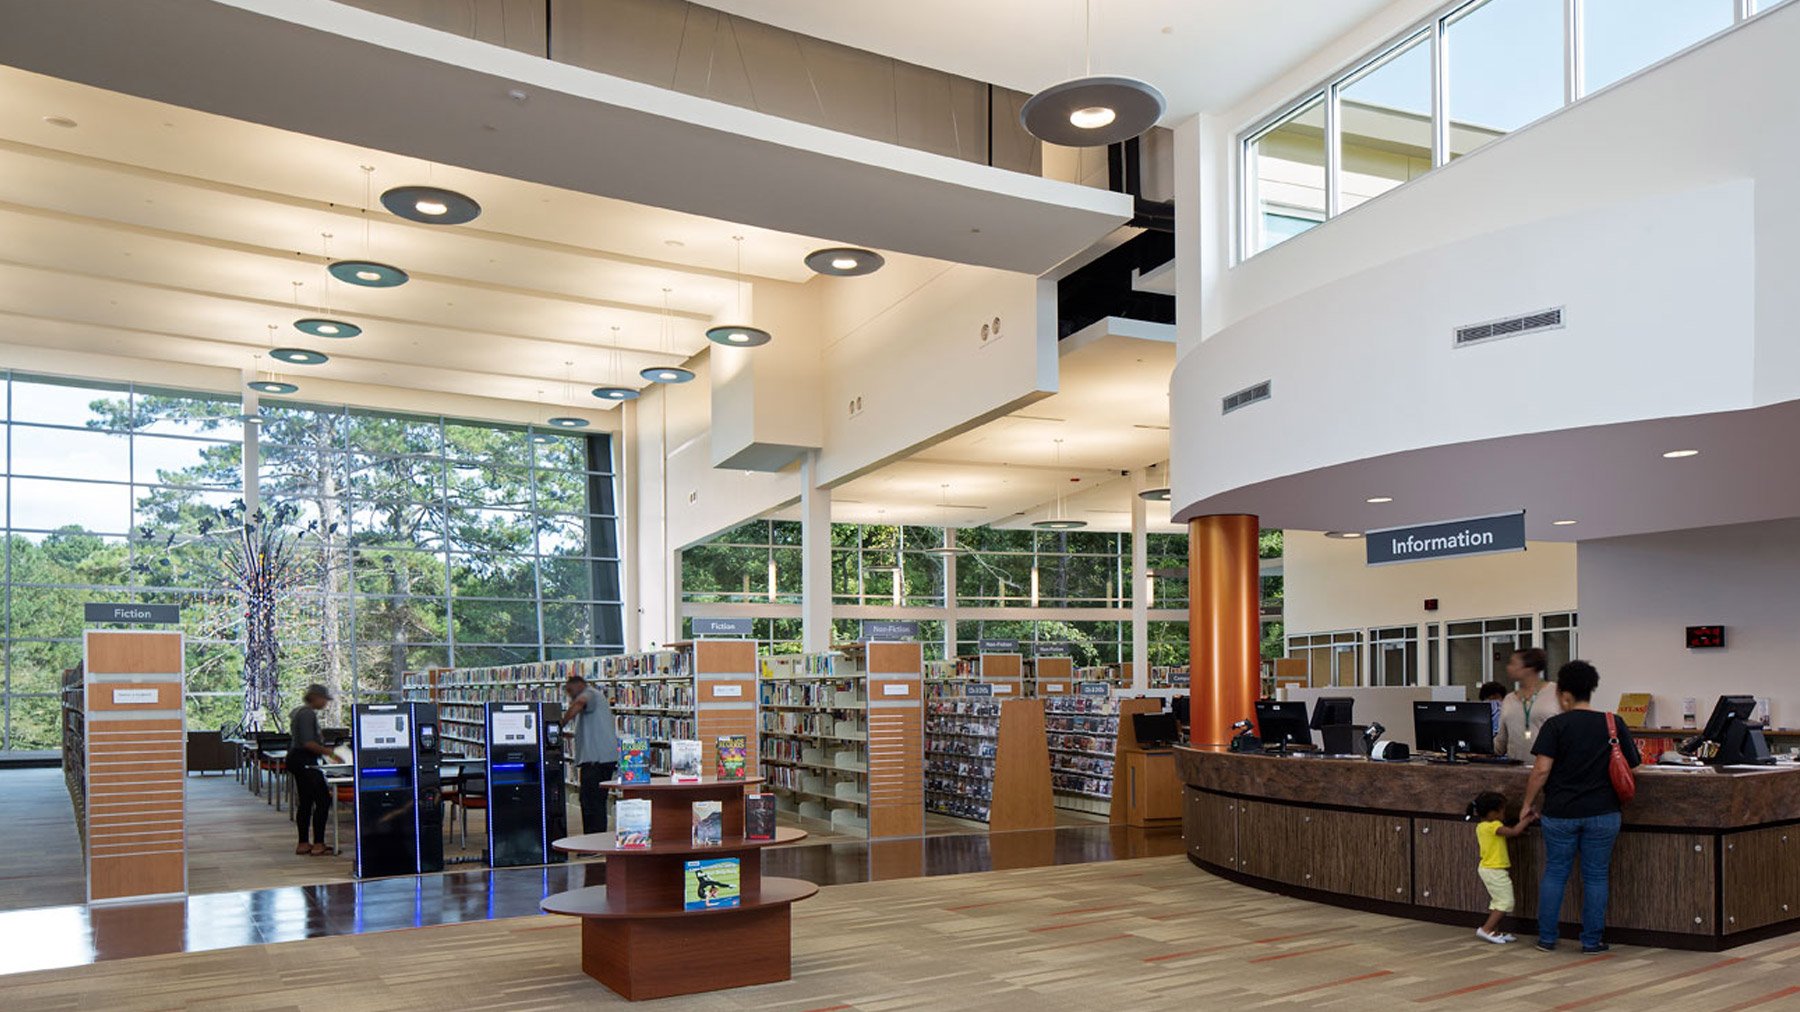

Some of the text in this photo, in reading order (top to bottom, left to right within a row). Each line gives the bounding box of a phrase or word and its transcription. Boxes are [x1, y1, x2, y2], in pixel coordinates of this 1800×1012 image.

[1392, 530, 1493, 554] Information
[114, 608, 152, 618] Fiction
[711, 622, 736, 630] Fiction
[873, 625, 911, 633] Non-Fiction
